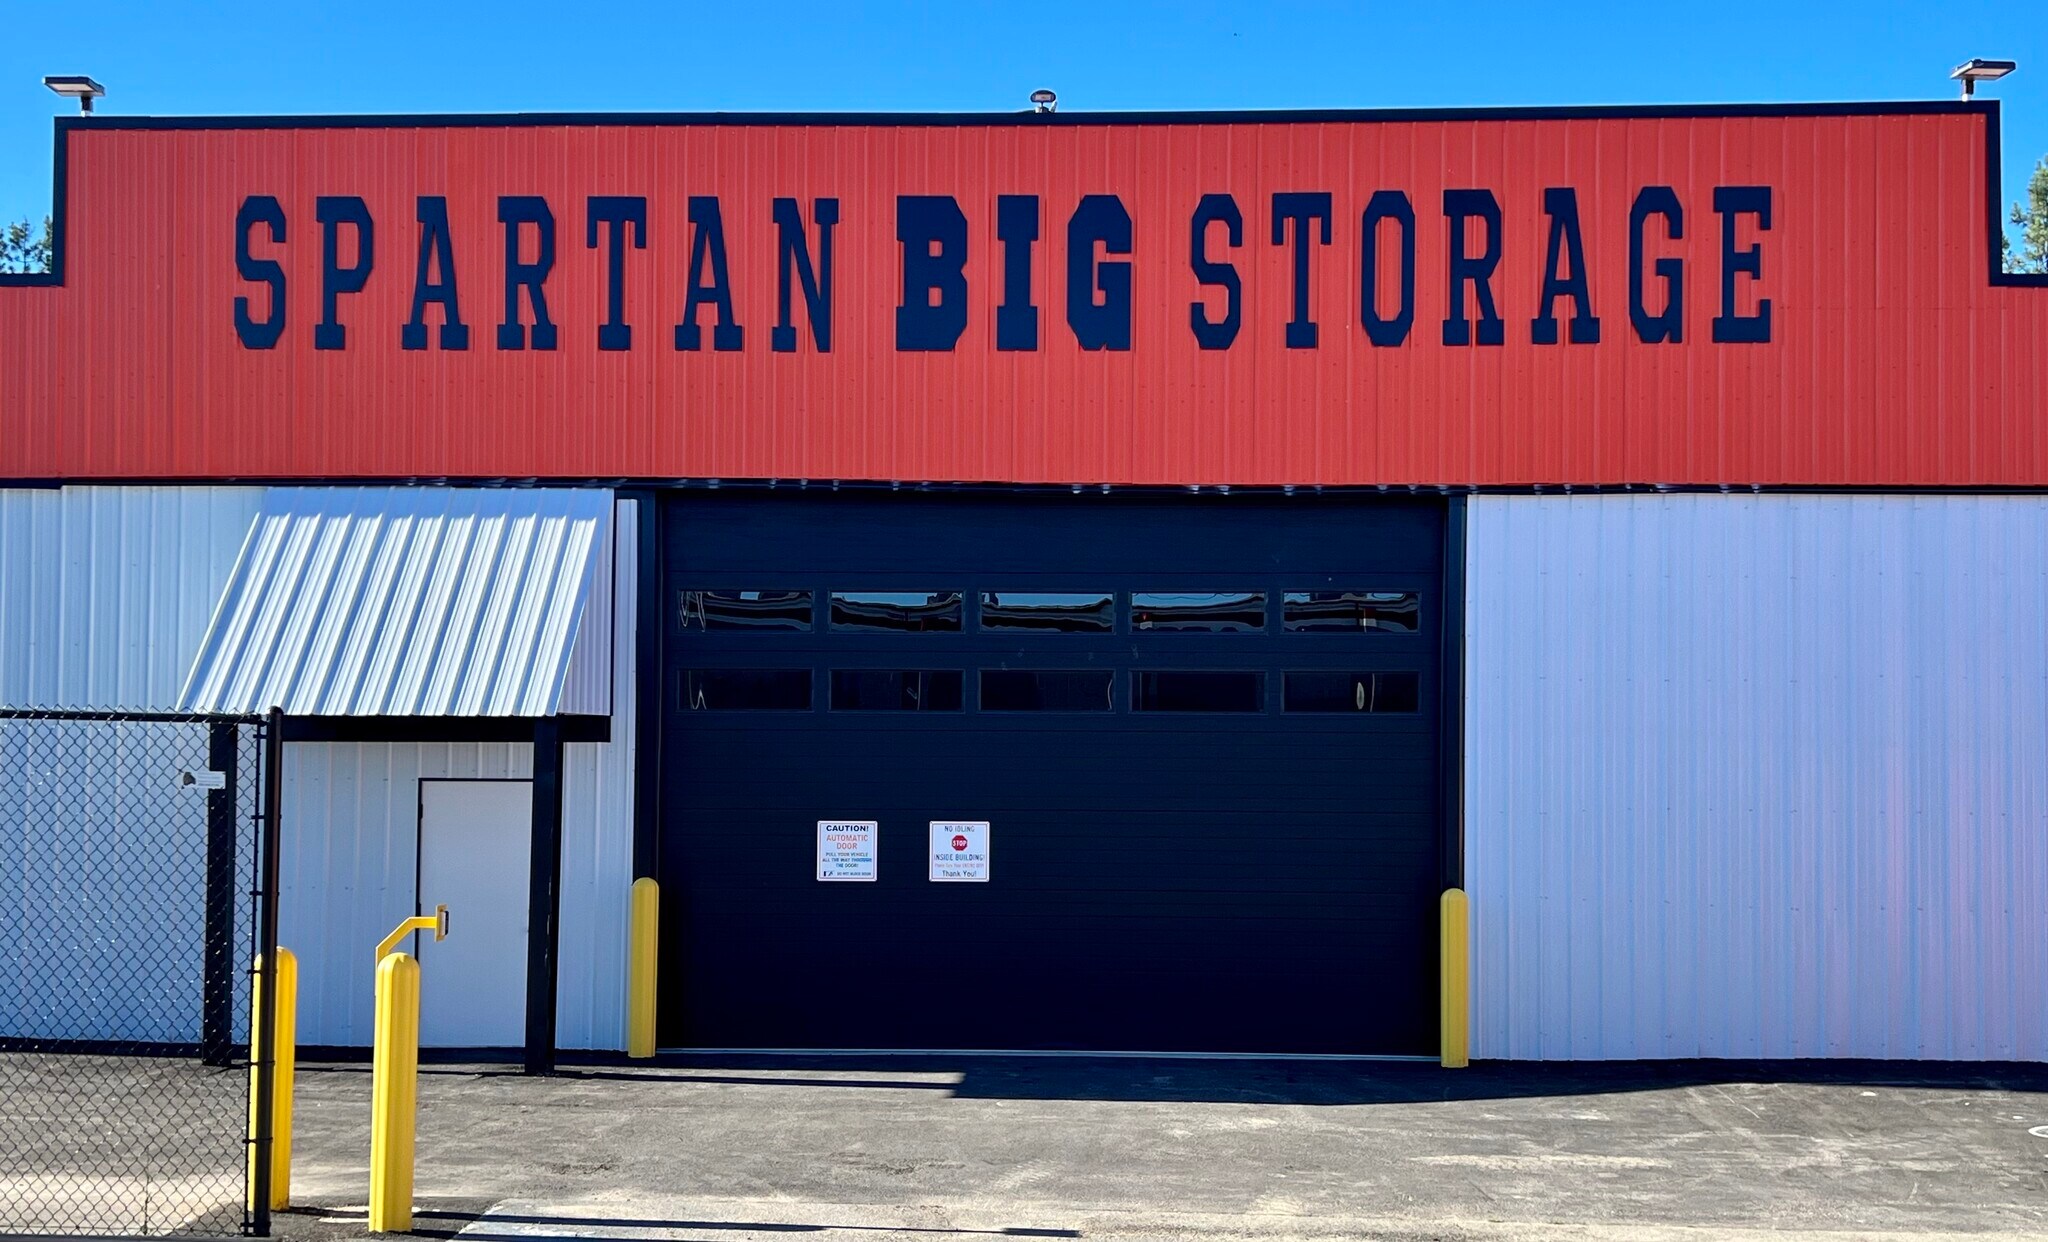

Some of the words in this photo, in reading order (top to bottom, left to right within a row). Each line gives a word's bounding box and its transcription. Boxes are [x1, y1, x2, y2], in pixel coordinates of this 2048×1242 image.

[234, 195, 840, 353] SPARTAN
[896, 195, 1133, 352] BIG
[1190, 185, 1772, 350] STORAGE
[827, 834, 869, 842] AUTOMATIC
